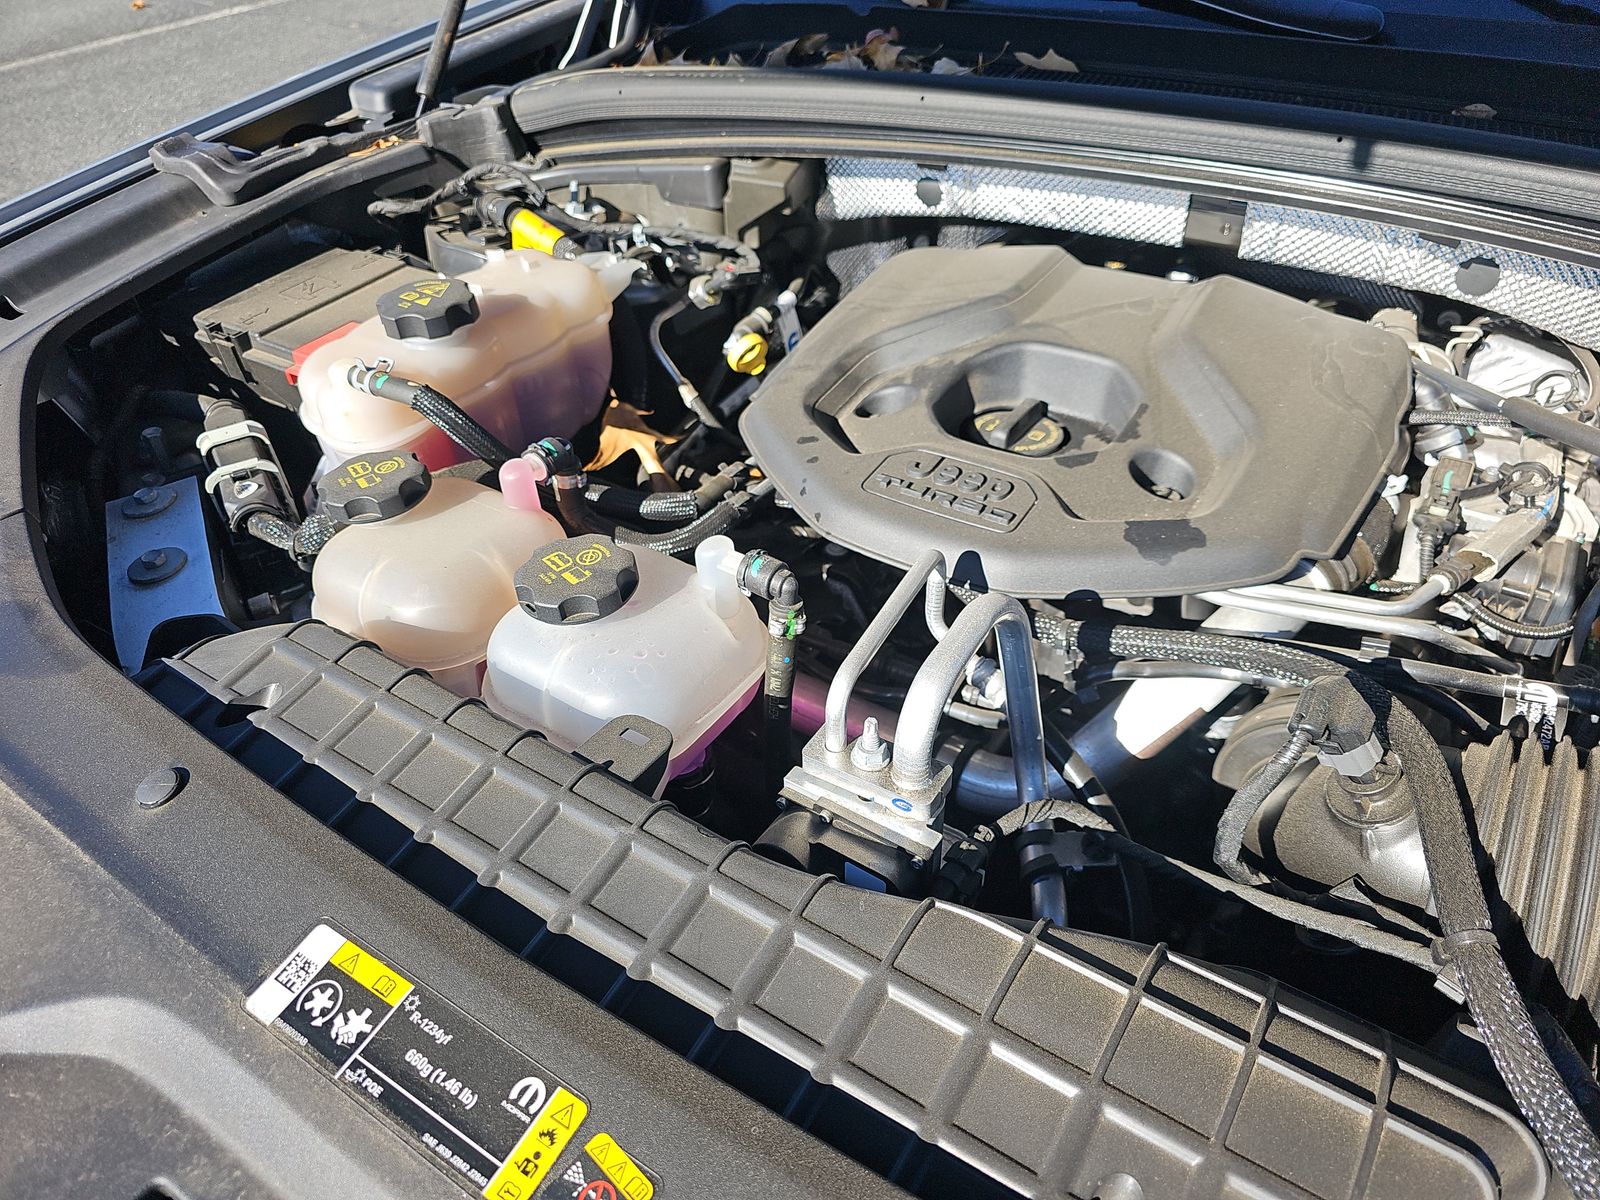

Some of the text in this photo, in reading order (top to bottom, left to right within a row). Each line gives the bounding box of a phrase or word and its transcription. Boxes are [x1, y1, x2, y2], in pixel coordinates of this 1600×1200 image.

[906, 457, 1015, 501] Jeep
[409, 1012, 454, 1046] R-1234yf
[362, 1077, 384, 1098] POE
[404, 1049, 479, 1110] 660g (1.46 lb)
[422, 1132, 439, 1149] SAE
